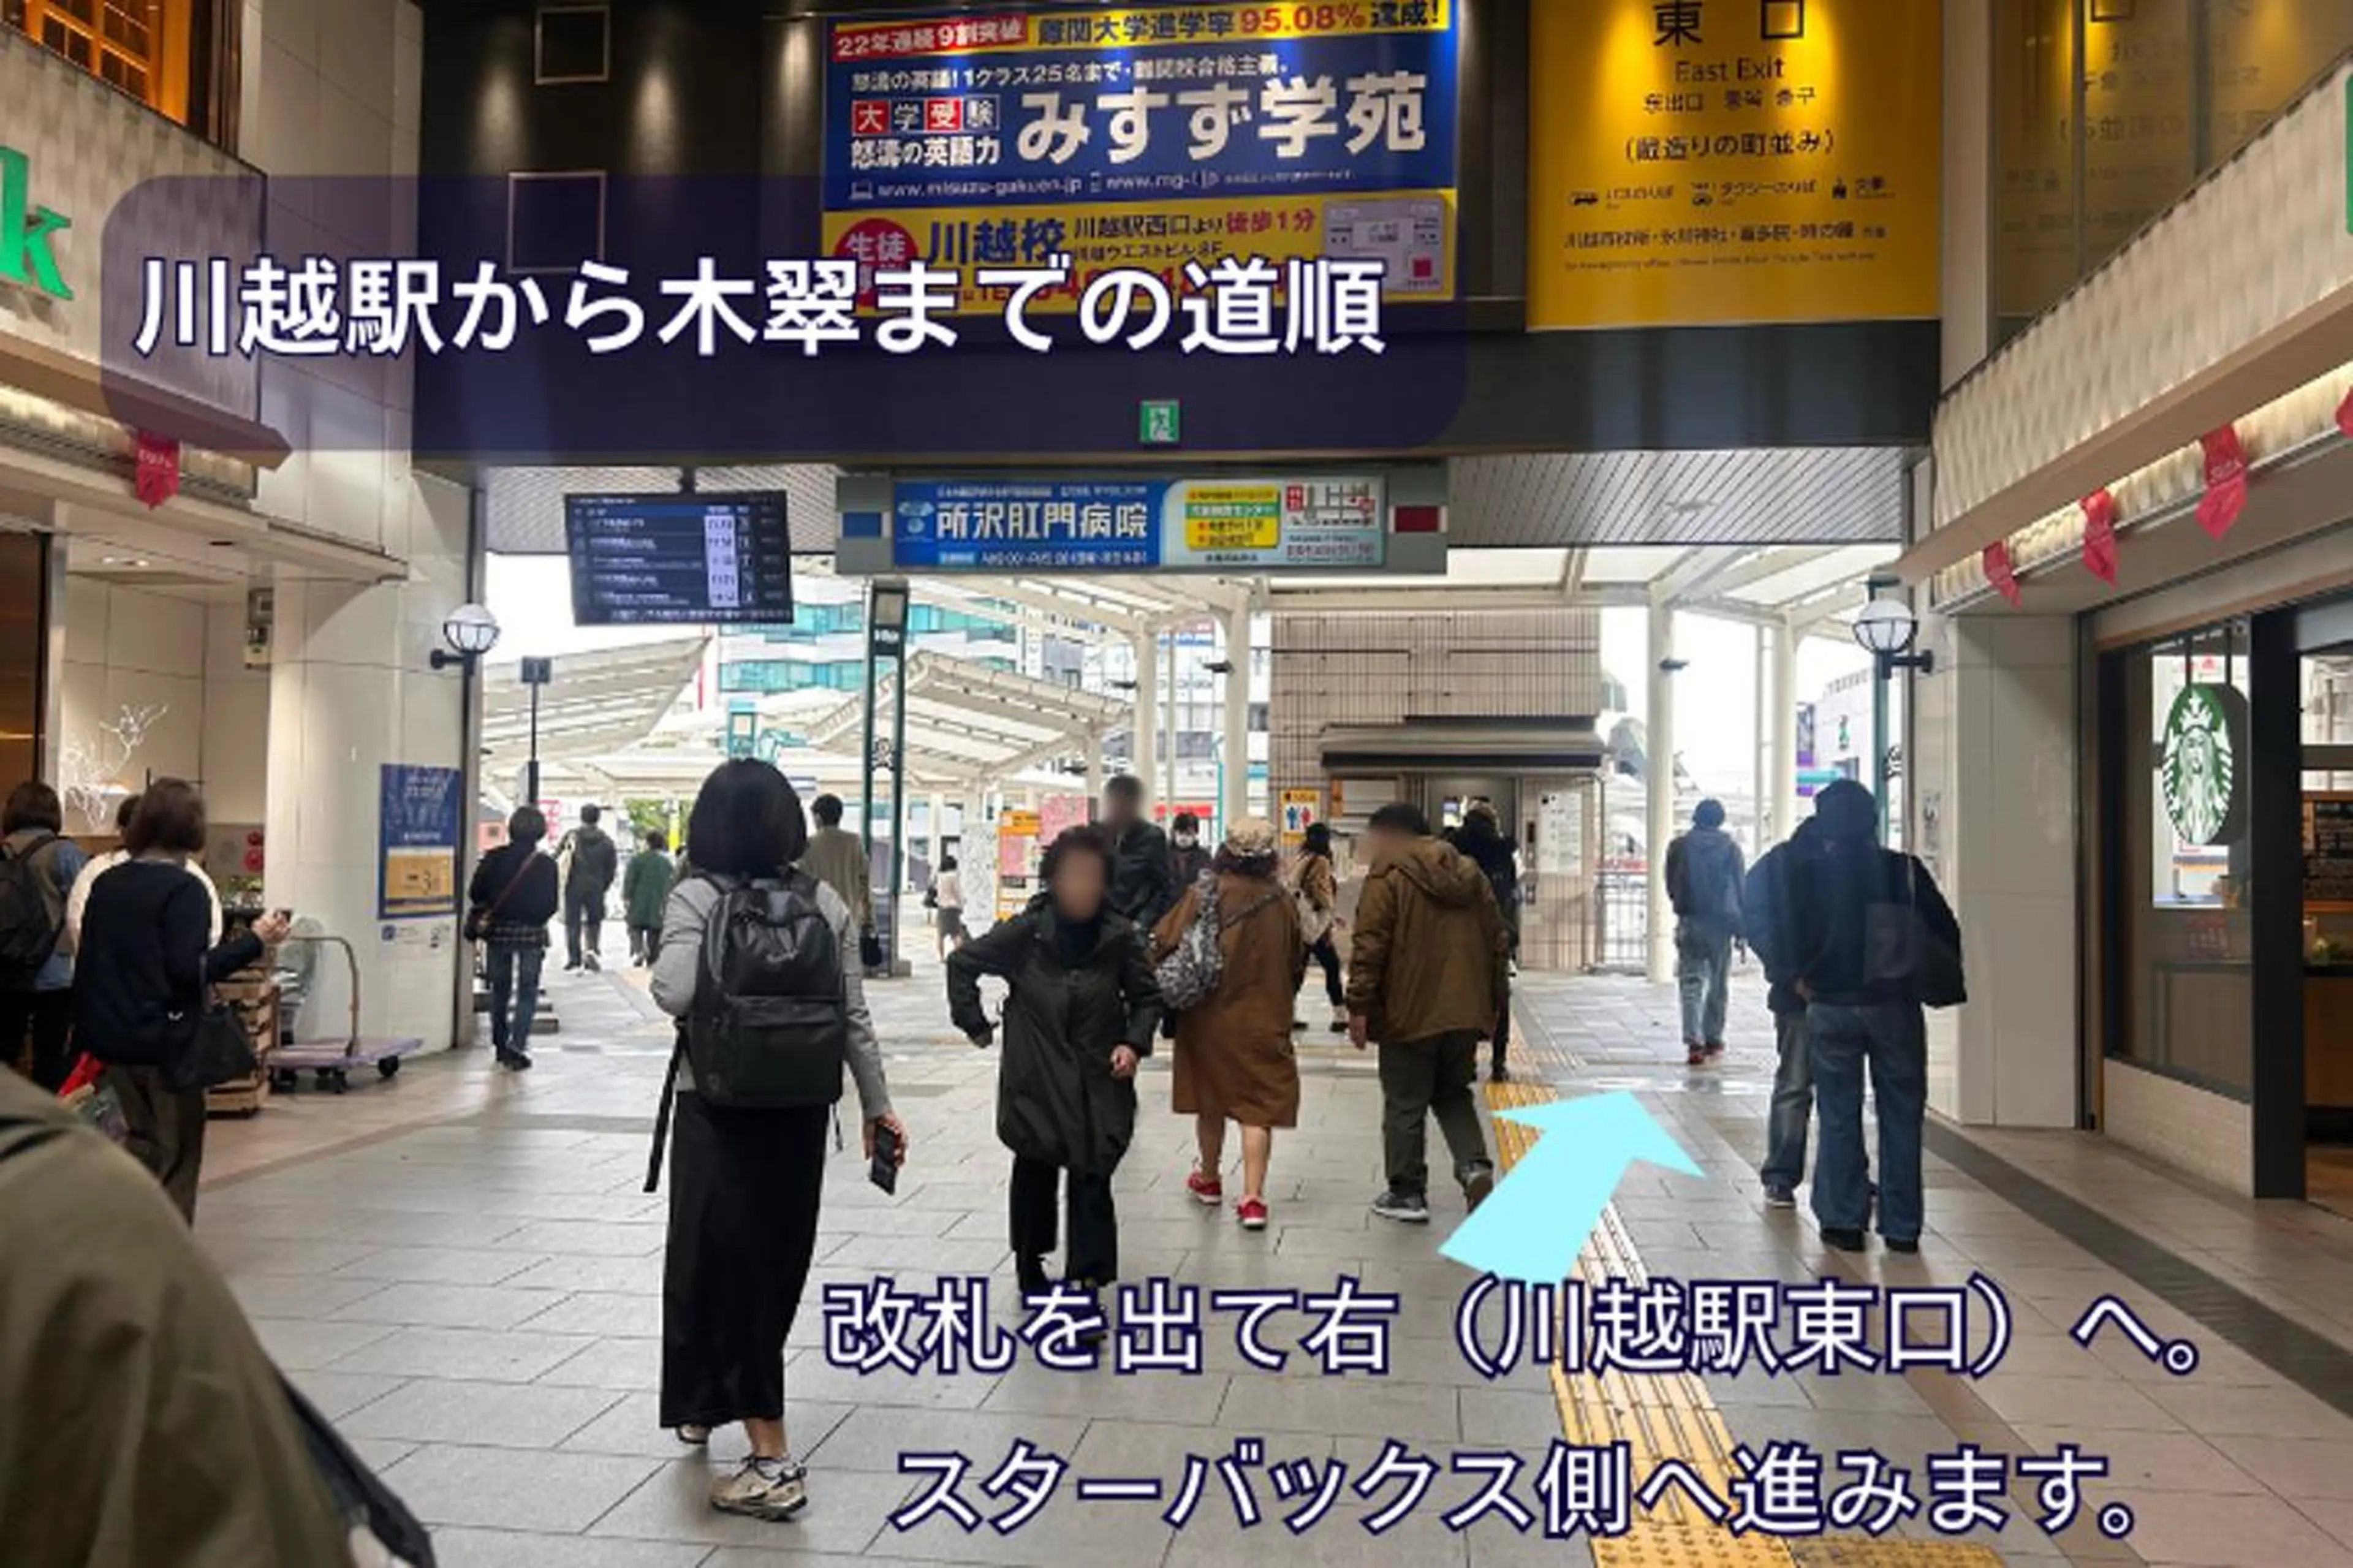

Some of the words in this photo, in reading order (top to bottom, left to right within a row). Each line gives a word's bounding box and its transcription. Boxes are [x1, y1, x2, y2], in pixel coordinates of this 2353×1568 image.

[1675, 61, 1728, 82] East
[1737, 57, 1784, 80] Exit
[855, 97, 996, 132] 大学受験
[1017, 70, 1426, 164] みすず学苑
[1074, 207, 1316, 239] 川越駅西口より徒歩1分
[844, 231, 907, 262] 生徒
[928, 218, 1066, 264] 川越校
[936, 502, 1148, 539] 所沢肛門病院
